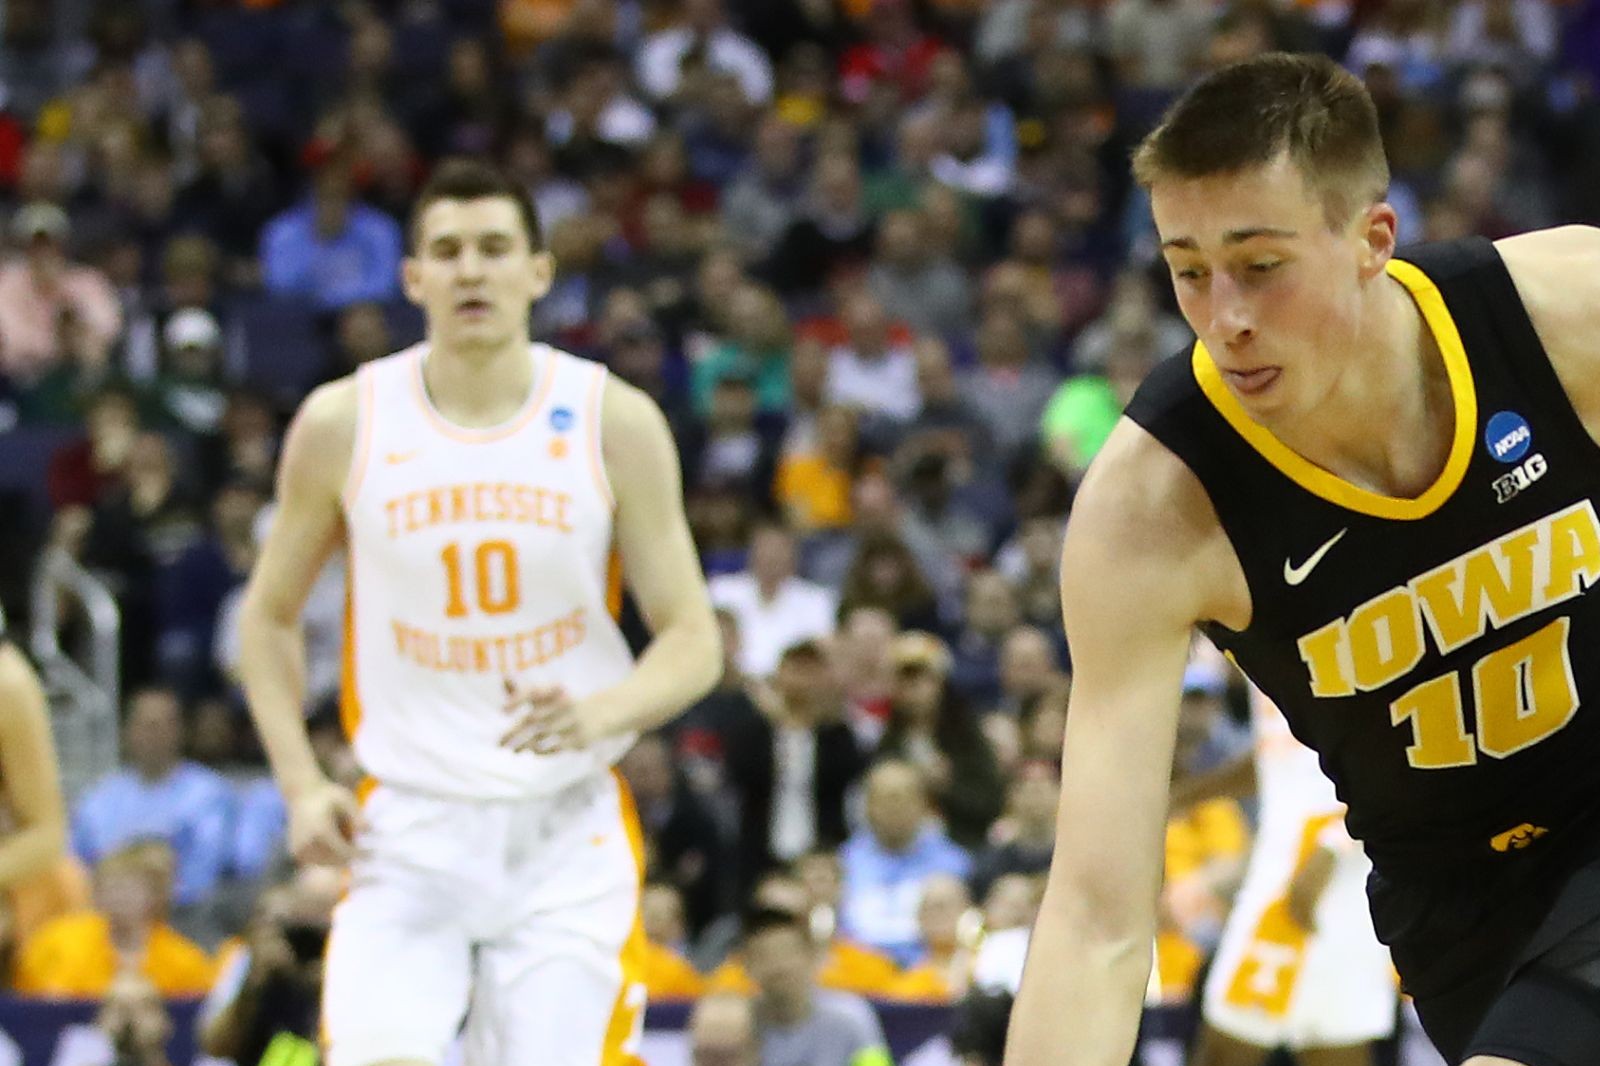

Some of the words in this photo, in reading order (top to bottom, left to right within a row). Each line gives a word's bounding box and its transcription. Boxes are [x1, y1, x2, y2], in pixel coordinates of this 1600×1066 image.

[1494, 426, 1530, 457] NCAA
[384, 482, 574, 539] TENNESSEE
[440, 539, 521, 620] 10
[390, 606, 588, 673] VOLUNTEERS
[1390, 615, 1581, 769] 10
